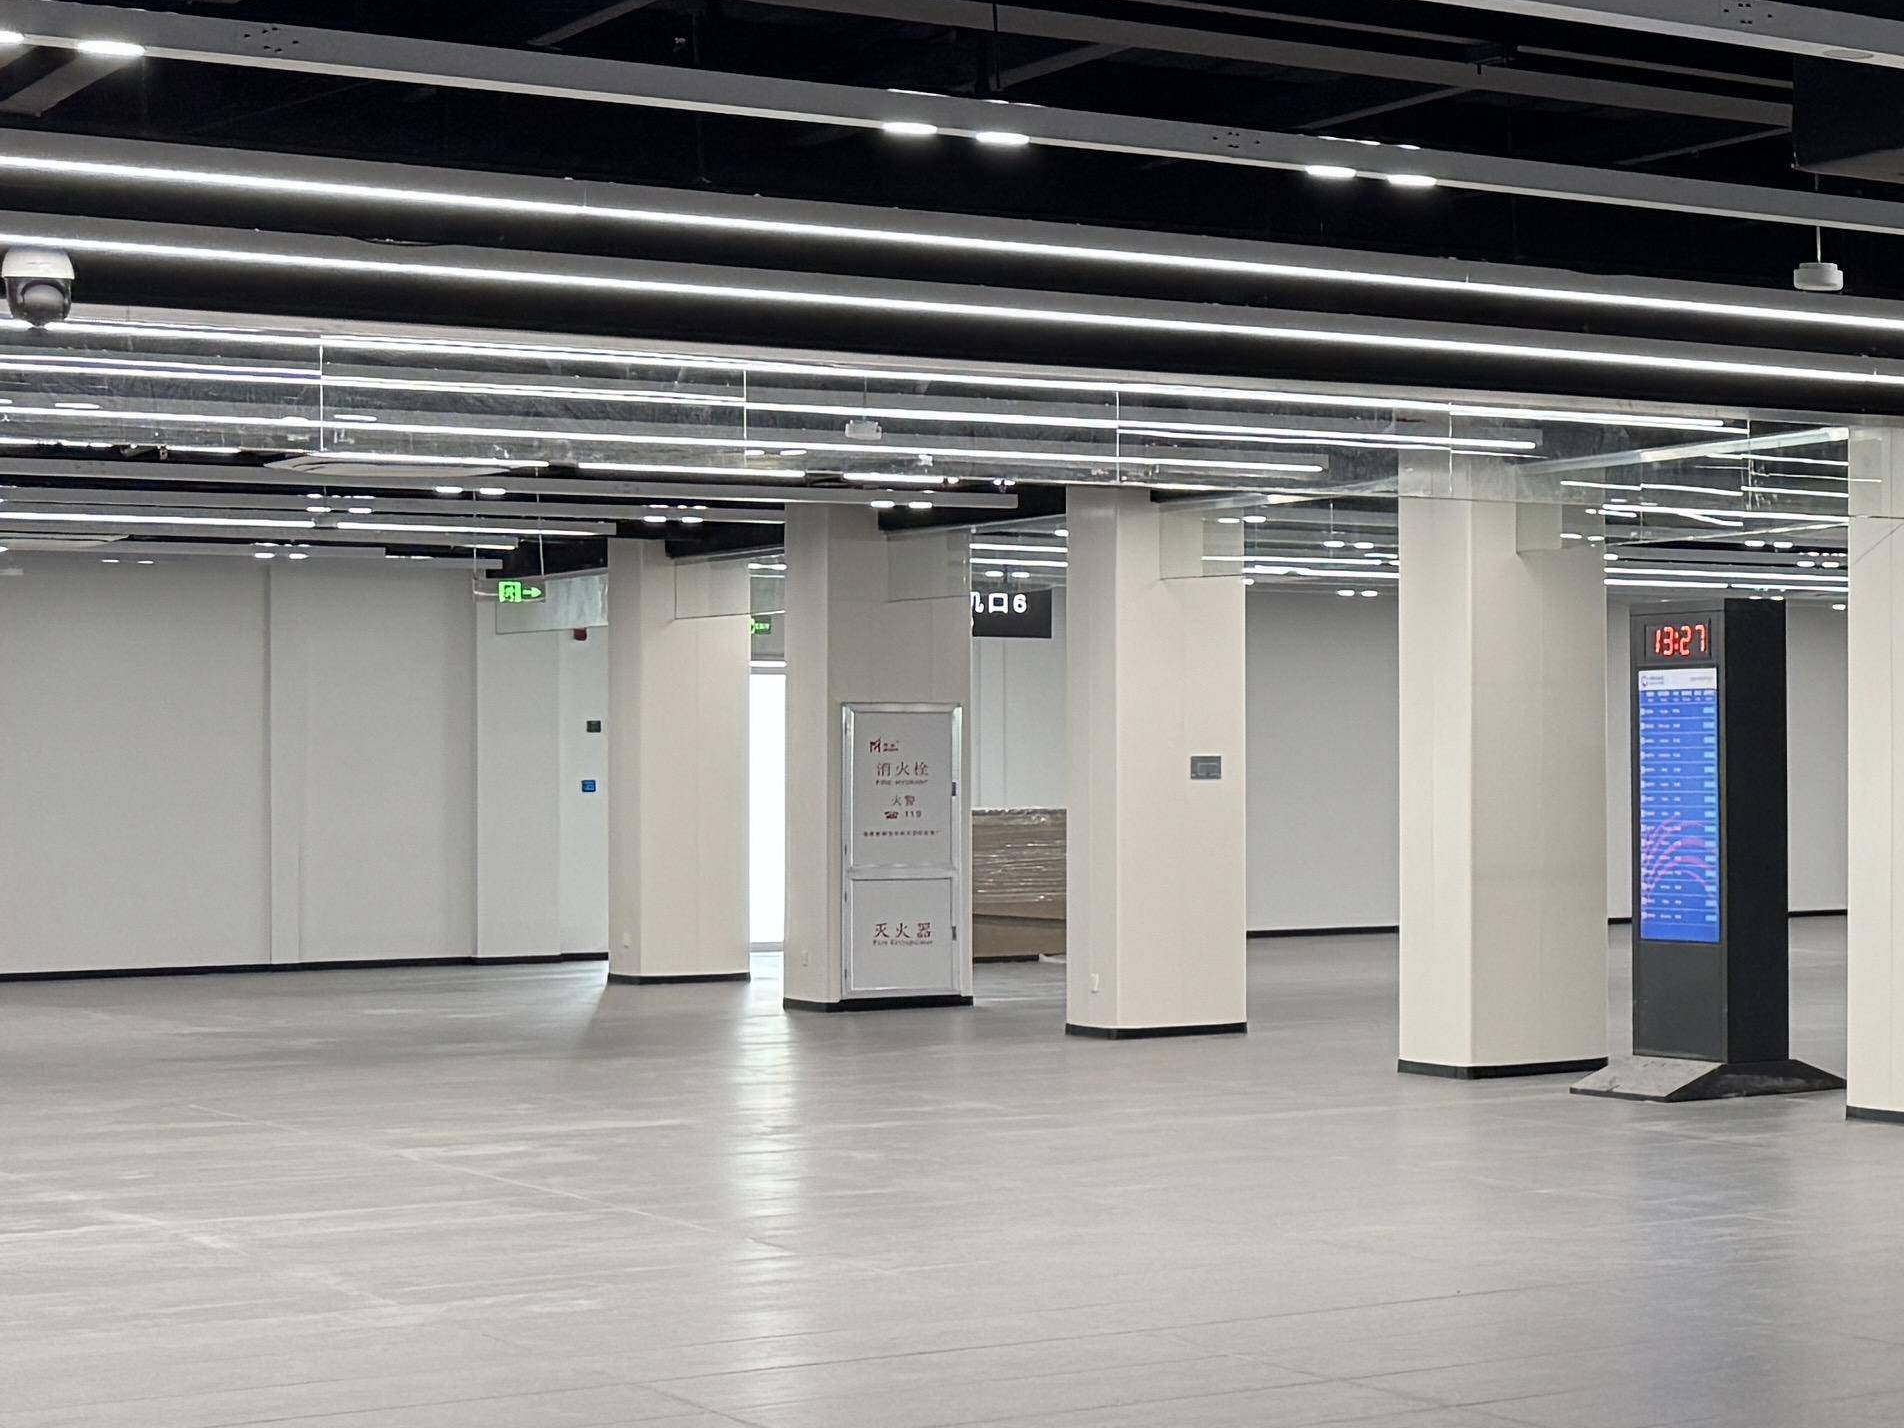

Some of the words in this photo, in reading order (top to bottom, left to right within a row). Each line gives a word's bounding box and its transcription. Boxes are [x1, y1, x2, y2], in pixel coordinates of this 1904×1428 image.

[1656, 625, 1706, 656] 13:27
[877, 761, 928, 776] 消火栓
[905, 810, 922, 818] 119
[873, 922, 931, 938] 灭火器
